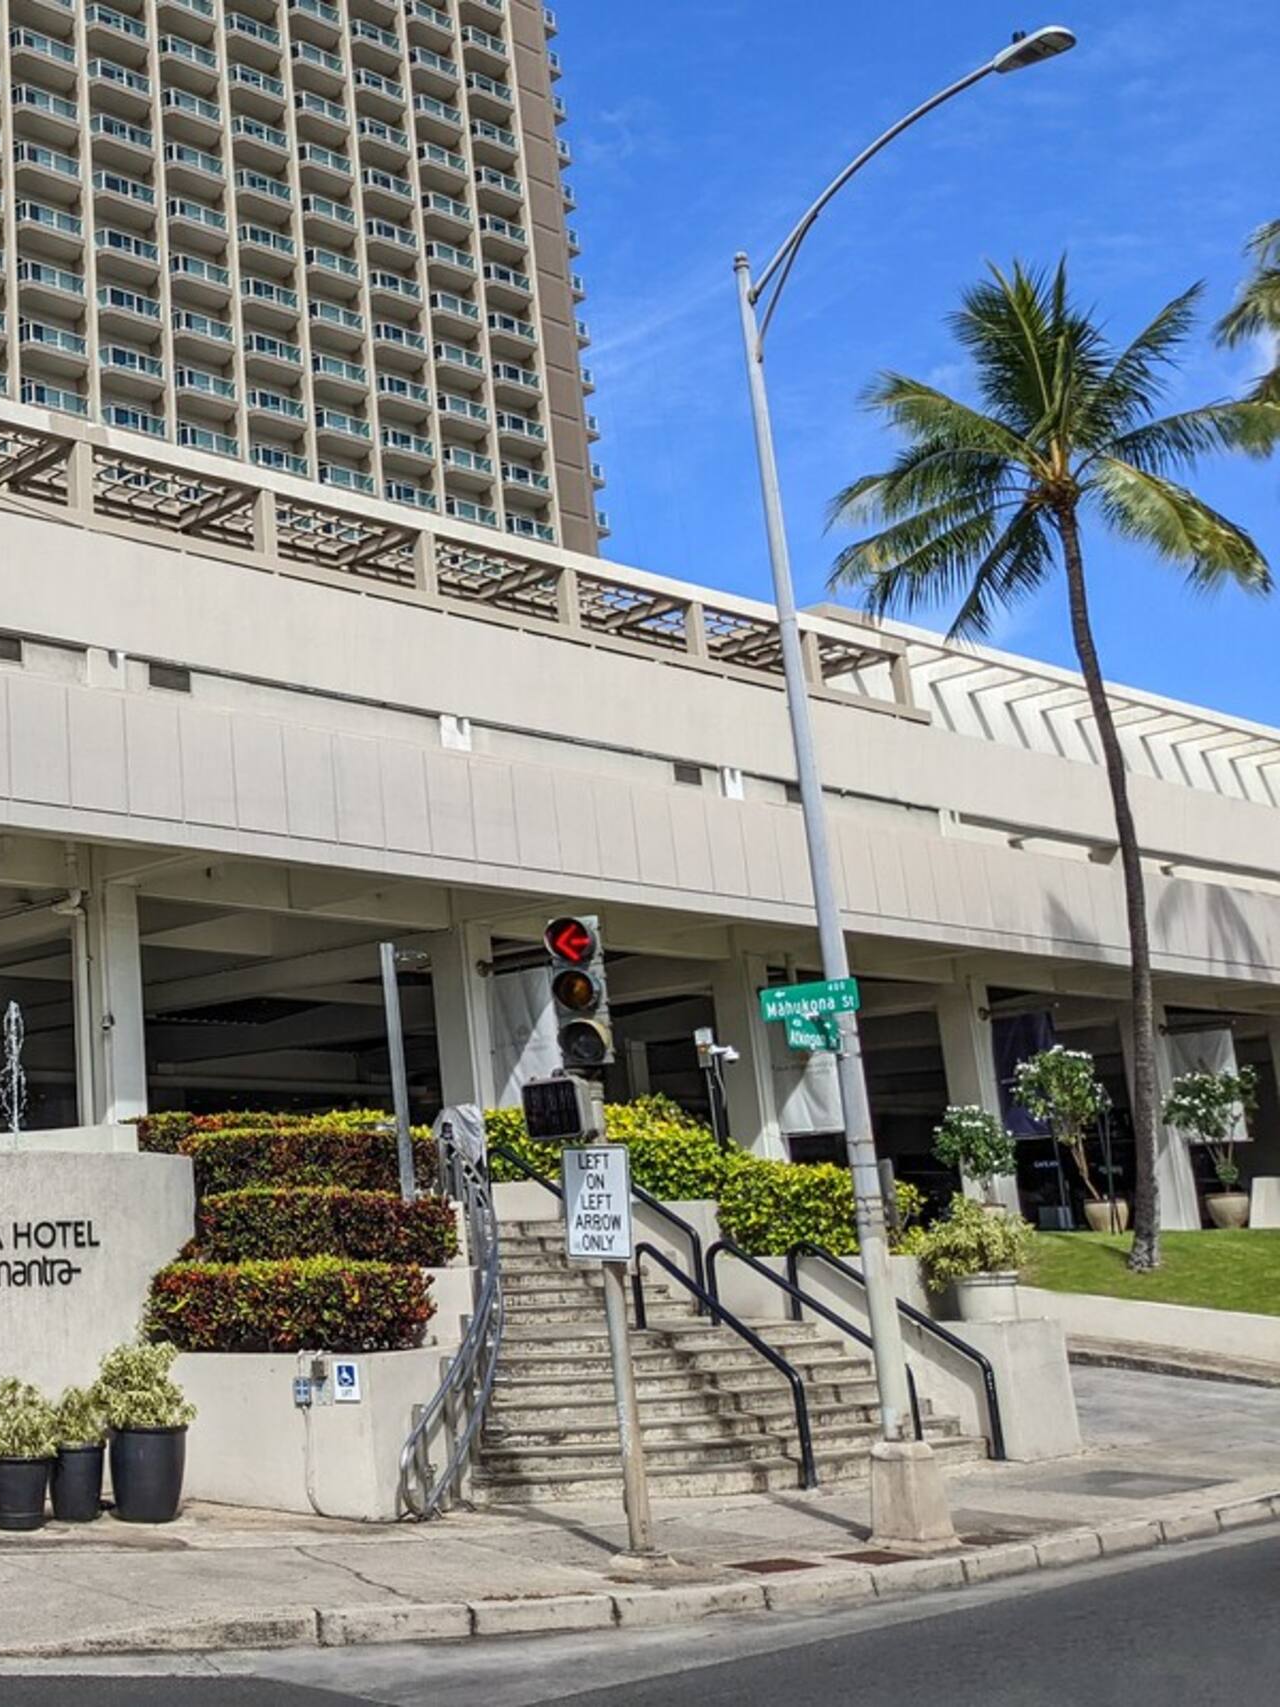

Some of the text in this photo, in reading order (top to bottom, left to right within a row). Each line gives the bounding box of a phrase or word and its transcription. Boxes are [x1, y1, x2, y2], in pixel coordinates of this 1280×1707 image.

[766, 994, 854, 1018] Mahukona St
[578, 1153, 609, 1170] LEFT
[586, 1173, 605, 1190] ON
[581, 1194, 611, 1210] LEFT
[575, 1214, 621, 1231] ARROW
[13, 1220, 100, 1250] HOTEL
[582, 1234, 615, 1251] ONLY
